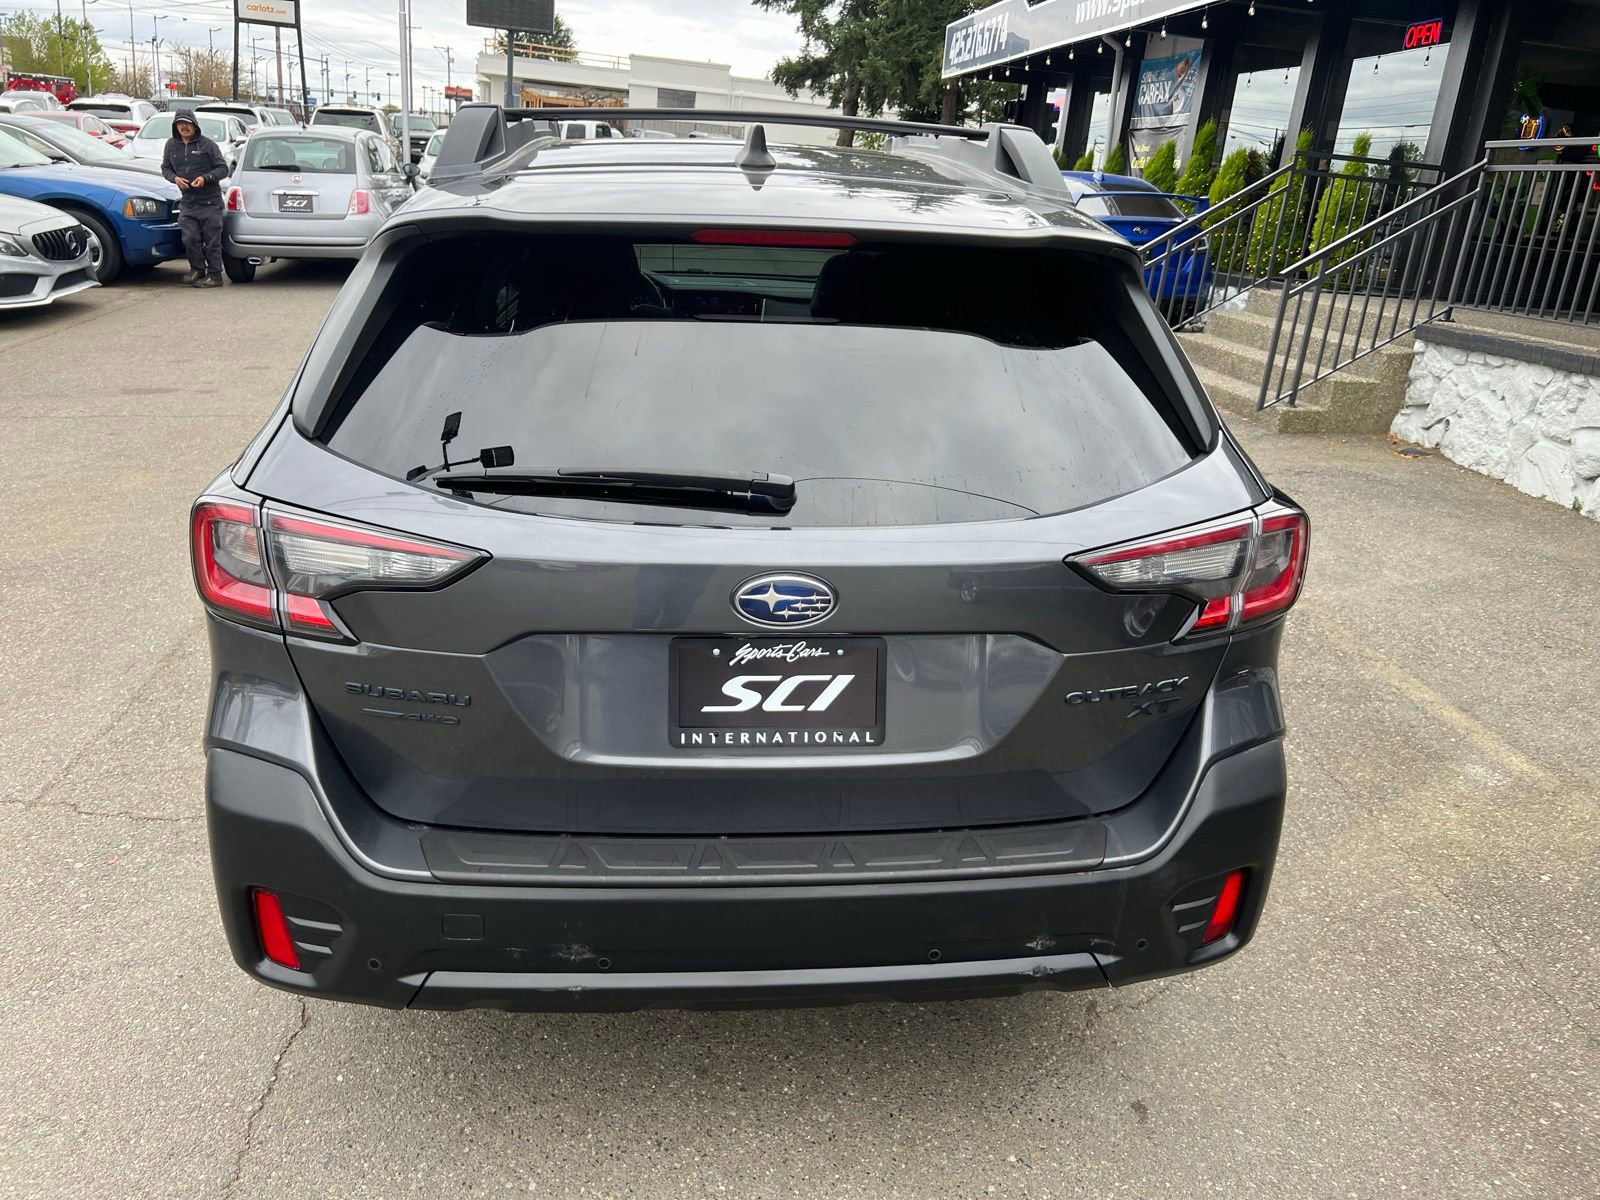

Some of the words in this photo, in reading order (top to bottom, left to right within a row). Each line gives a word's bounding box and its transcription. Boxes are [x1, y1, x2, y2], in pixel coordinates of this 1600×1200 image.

[1405, 21, 1441, 49] OPEN
[1138, 80, 1172, 105] CARFAX
[728, 642, 786, 667] Sports
[785, 641, 830, 663] Cars
[343, 681, 472, 707] SUBARU
[700, 674, 856, 712] SCI
[1064, 676, 1190, 704] OUTBACK
[1125, 696, 1181, 719] XT
[680, 731, 875, 746] INTERNATIONAL
